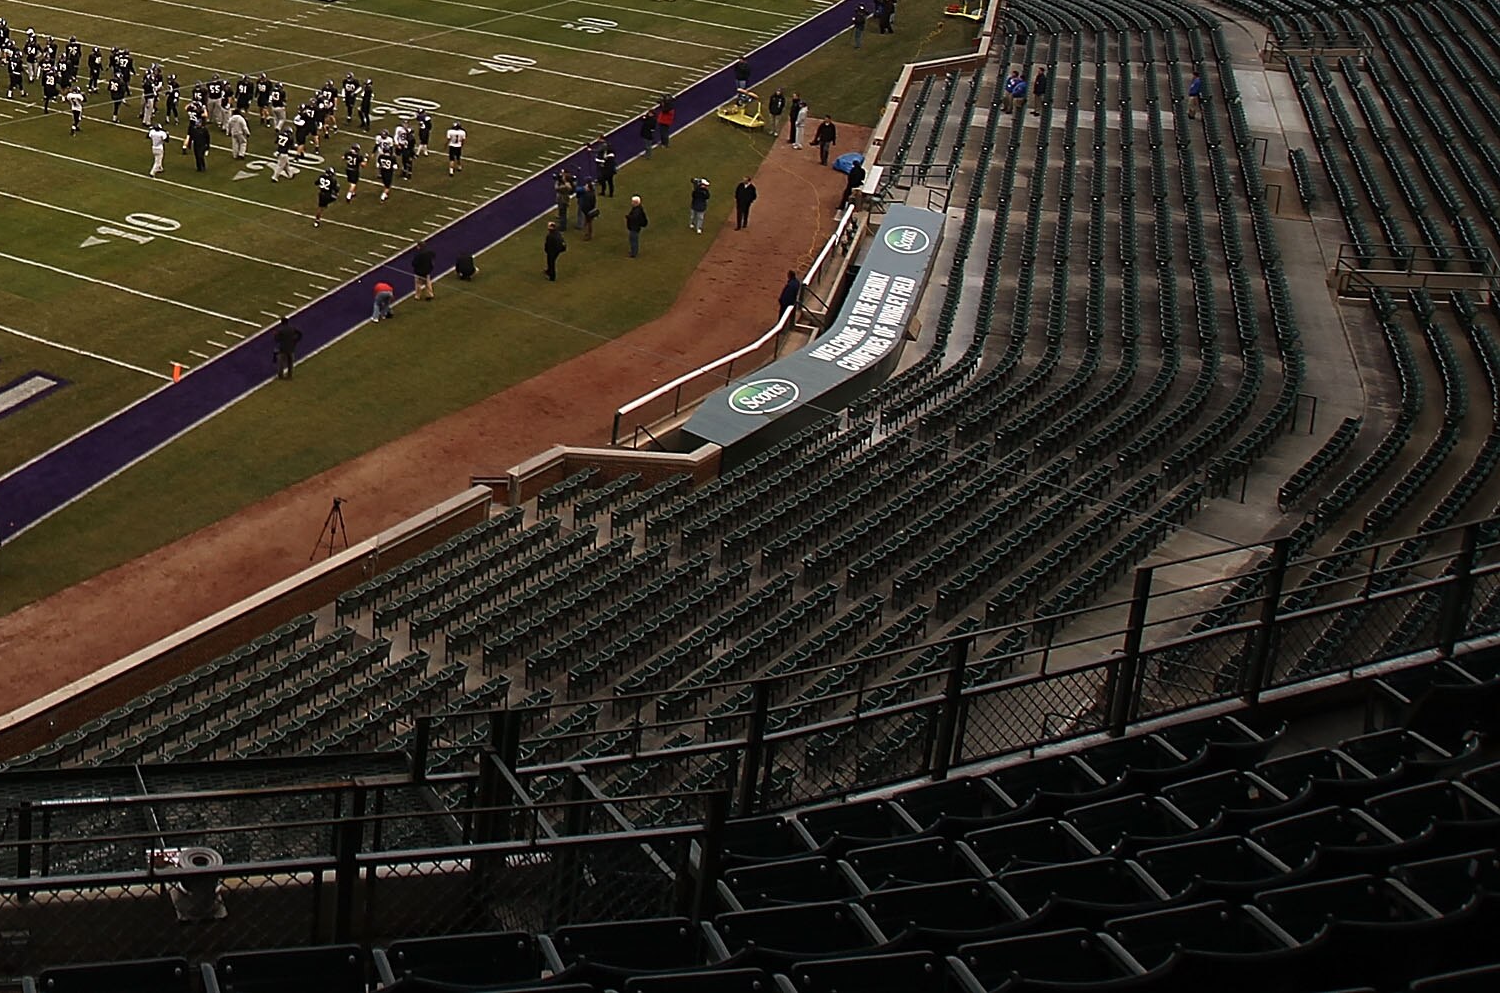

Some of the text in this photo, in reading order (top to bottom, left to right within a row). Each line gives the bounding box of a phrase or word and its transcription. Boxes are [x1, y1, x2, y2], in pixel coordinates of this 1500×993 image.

[209, 84, 221, 94] 55
[238, 84, 247, 94] 91
[278, 135, 288, 147] 27
[347, 156, 357, 166] 21
[319, 177, 331, 190] 92
[96, 212, 181, 246] 10
[893, 229, 920, 251] Scotts
[808, 270, 891, 362] WELCOME TO THE FRIENDLY
[835, 275, 916, 372] CONFINES OF WRIGLEY FIELD
